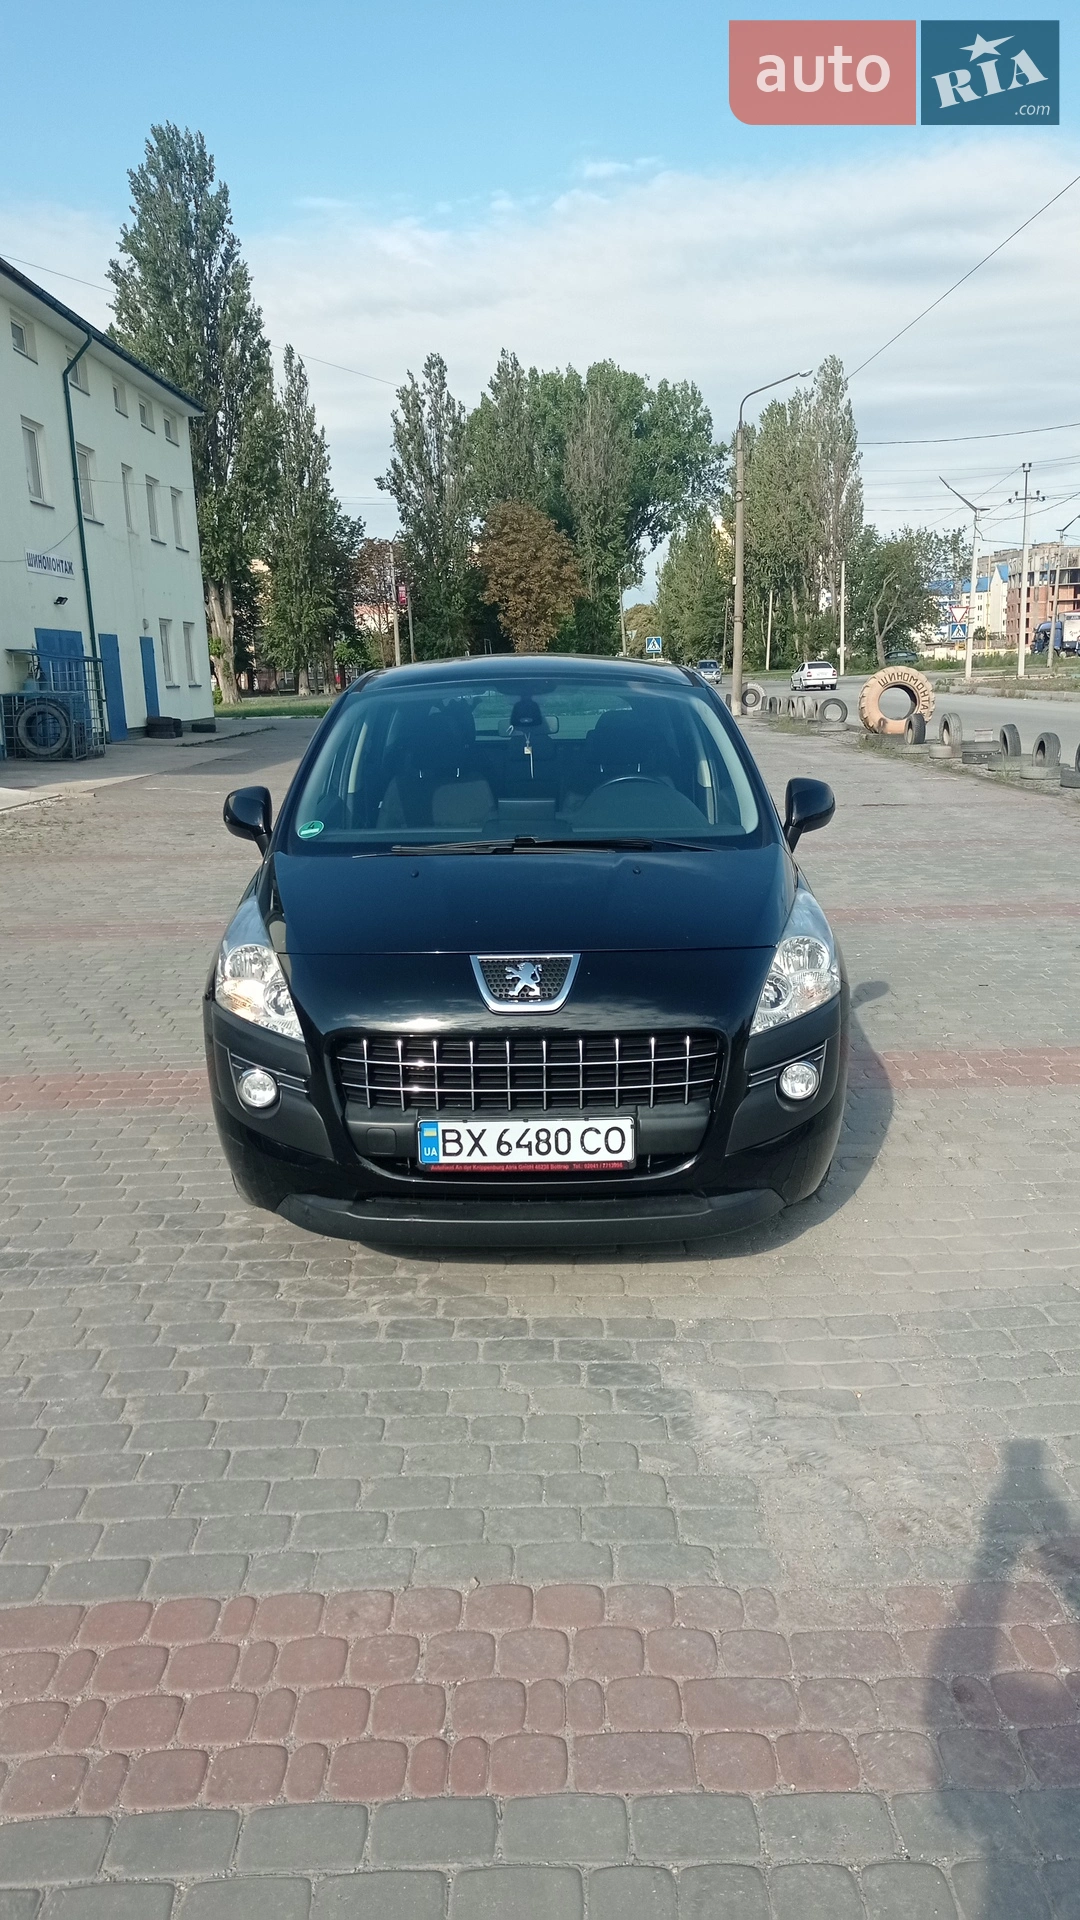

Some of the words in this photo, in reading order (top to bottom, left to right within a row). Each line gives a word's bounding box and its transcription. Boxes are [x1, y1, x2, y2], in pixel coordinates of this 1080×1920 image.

[26, 552, 74, 575] ШИНОМОНТАЖ
[423, 1147, 438, 1157] UA
[441, 1128, 488, 1157] BX
[496, 1127, 572, 1157] 6480
[579, 1126, 626, 1155] CO
